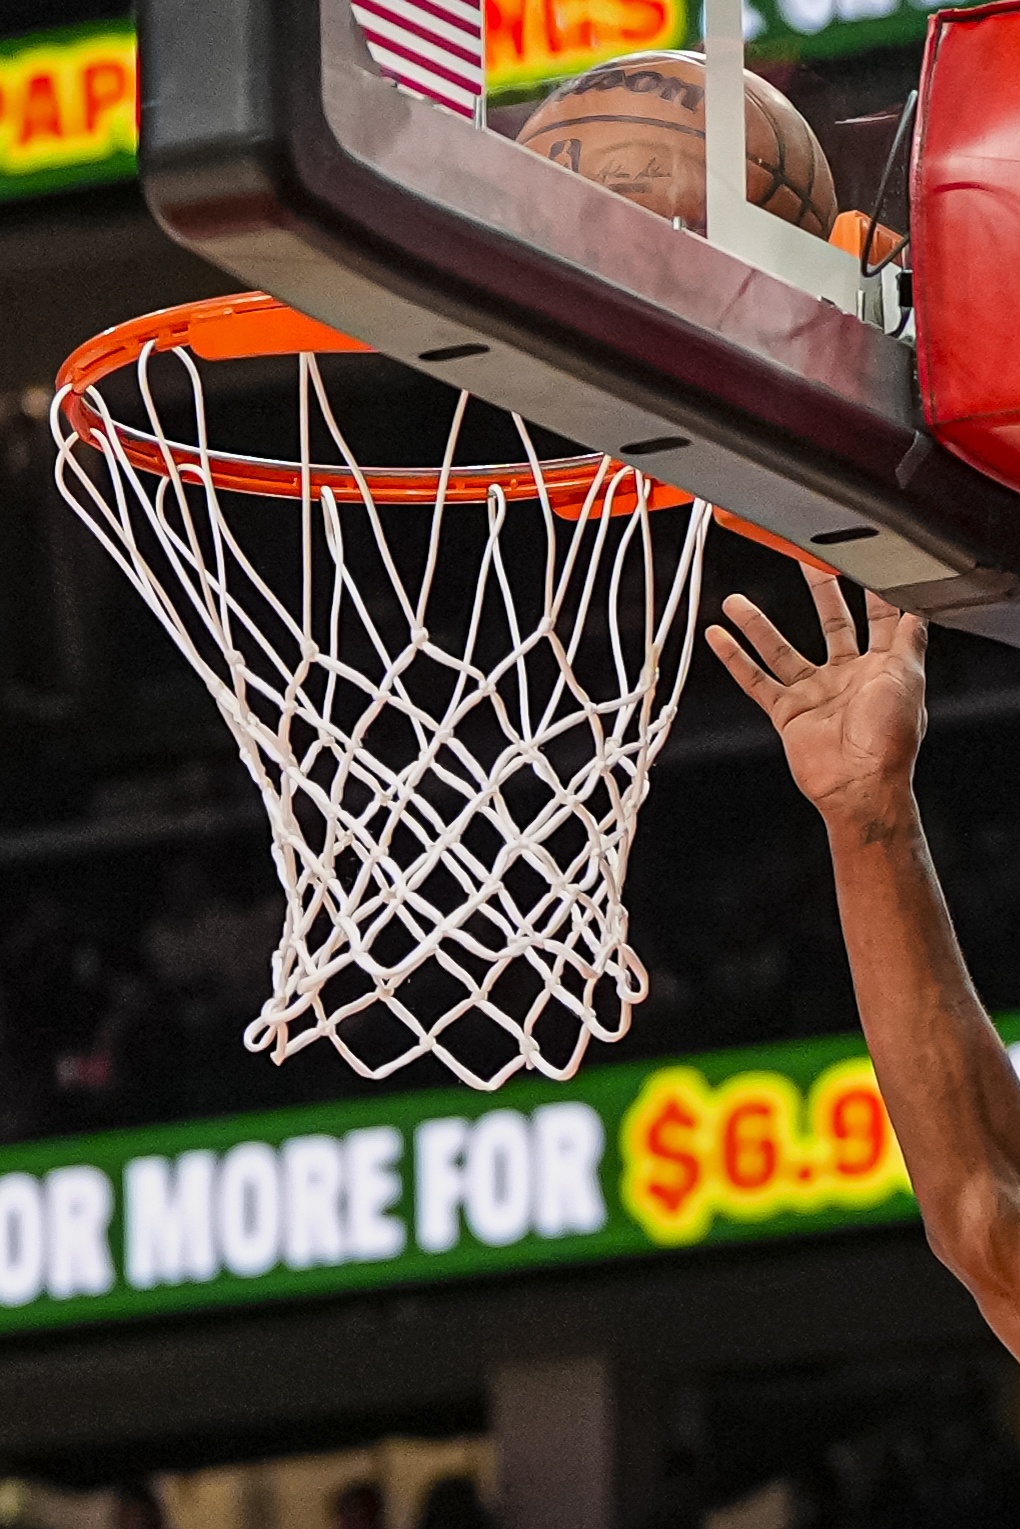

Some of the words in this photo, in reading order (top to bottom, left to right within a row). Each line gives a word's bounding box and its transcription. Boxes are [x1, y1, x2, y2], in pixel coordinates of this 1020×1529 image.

[0, 1163, 117, 1308] OR
[124, 1125, 407, 1290] MORE
[414, 1101, 607, 1253] FOR
[634, 1078, 900, 1230] $6.9
